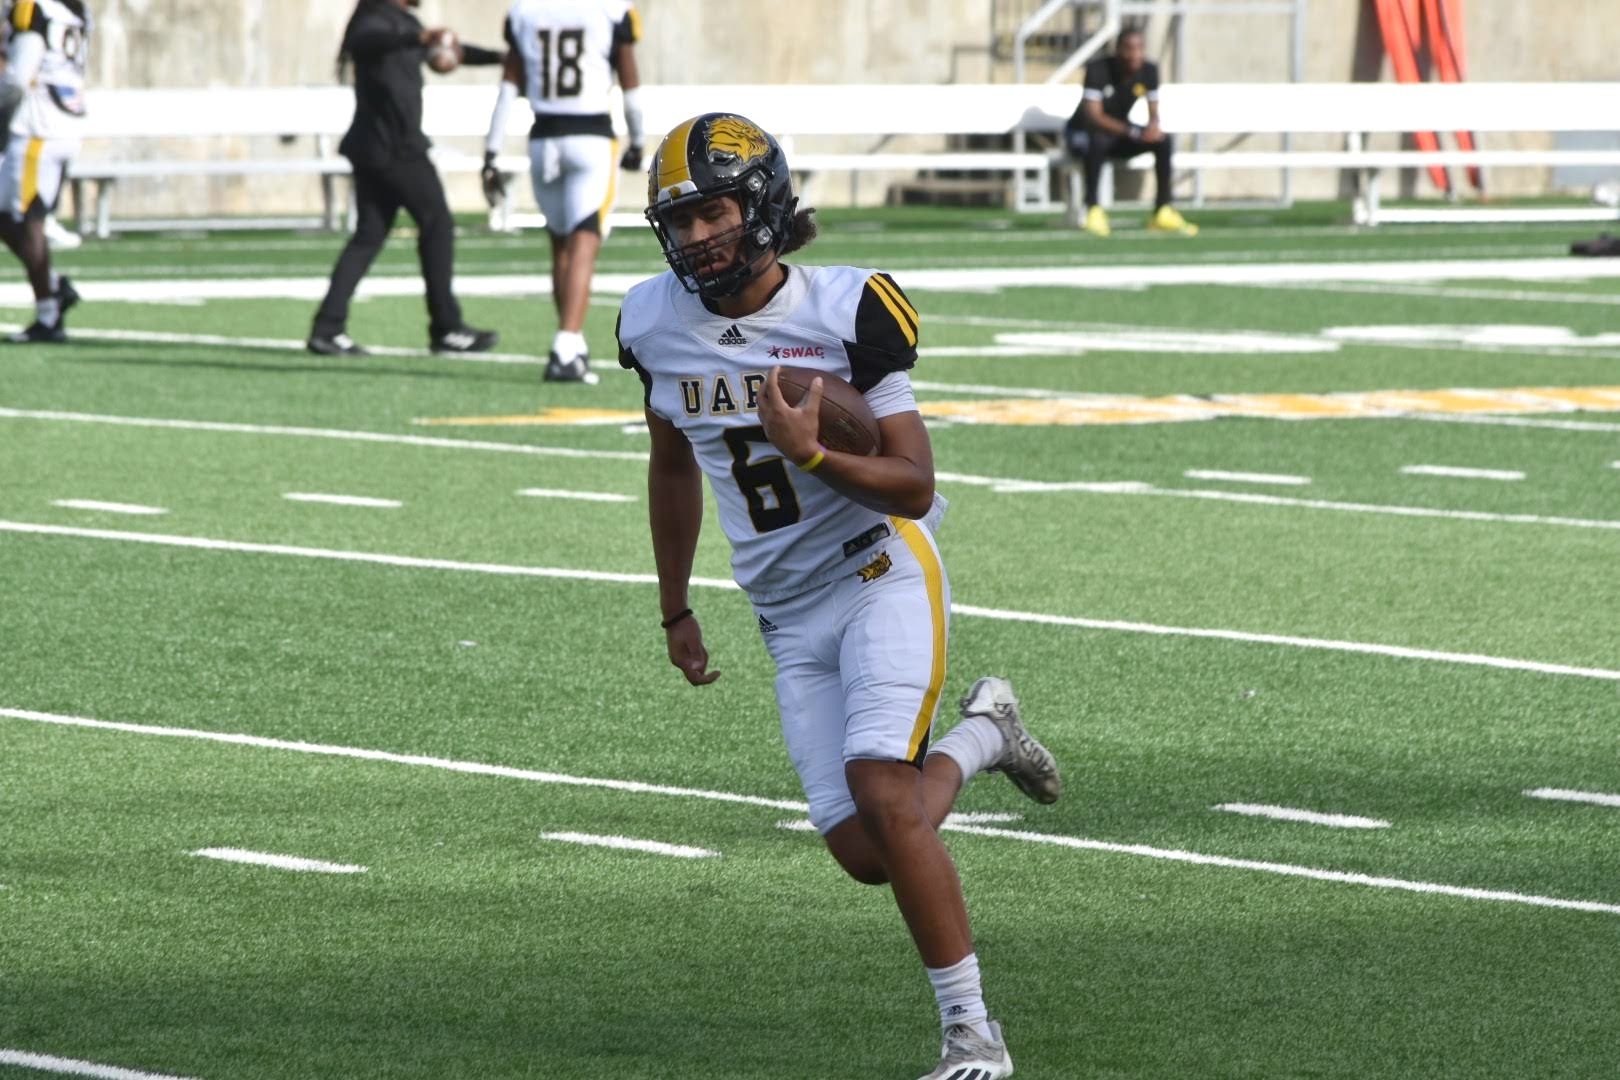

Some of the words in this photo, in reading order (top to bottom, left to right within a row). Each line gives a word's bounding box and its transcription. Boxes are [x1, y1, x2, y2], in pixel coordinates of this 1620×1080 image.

[537, 28, 585, 98] 18
[718, 336, 748, 346] adidas
[782, 346, 825, 359] SWAC
[679, 371, 768, 418] UAP
[722, 423, 803, 534] 6
